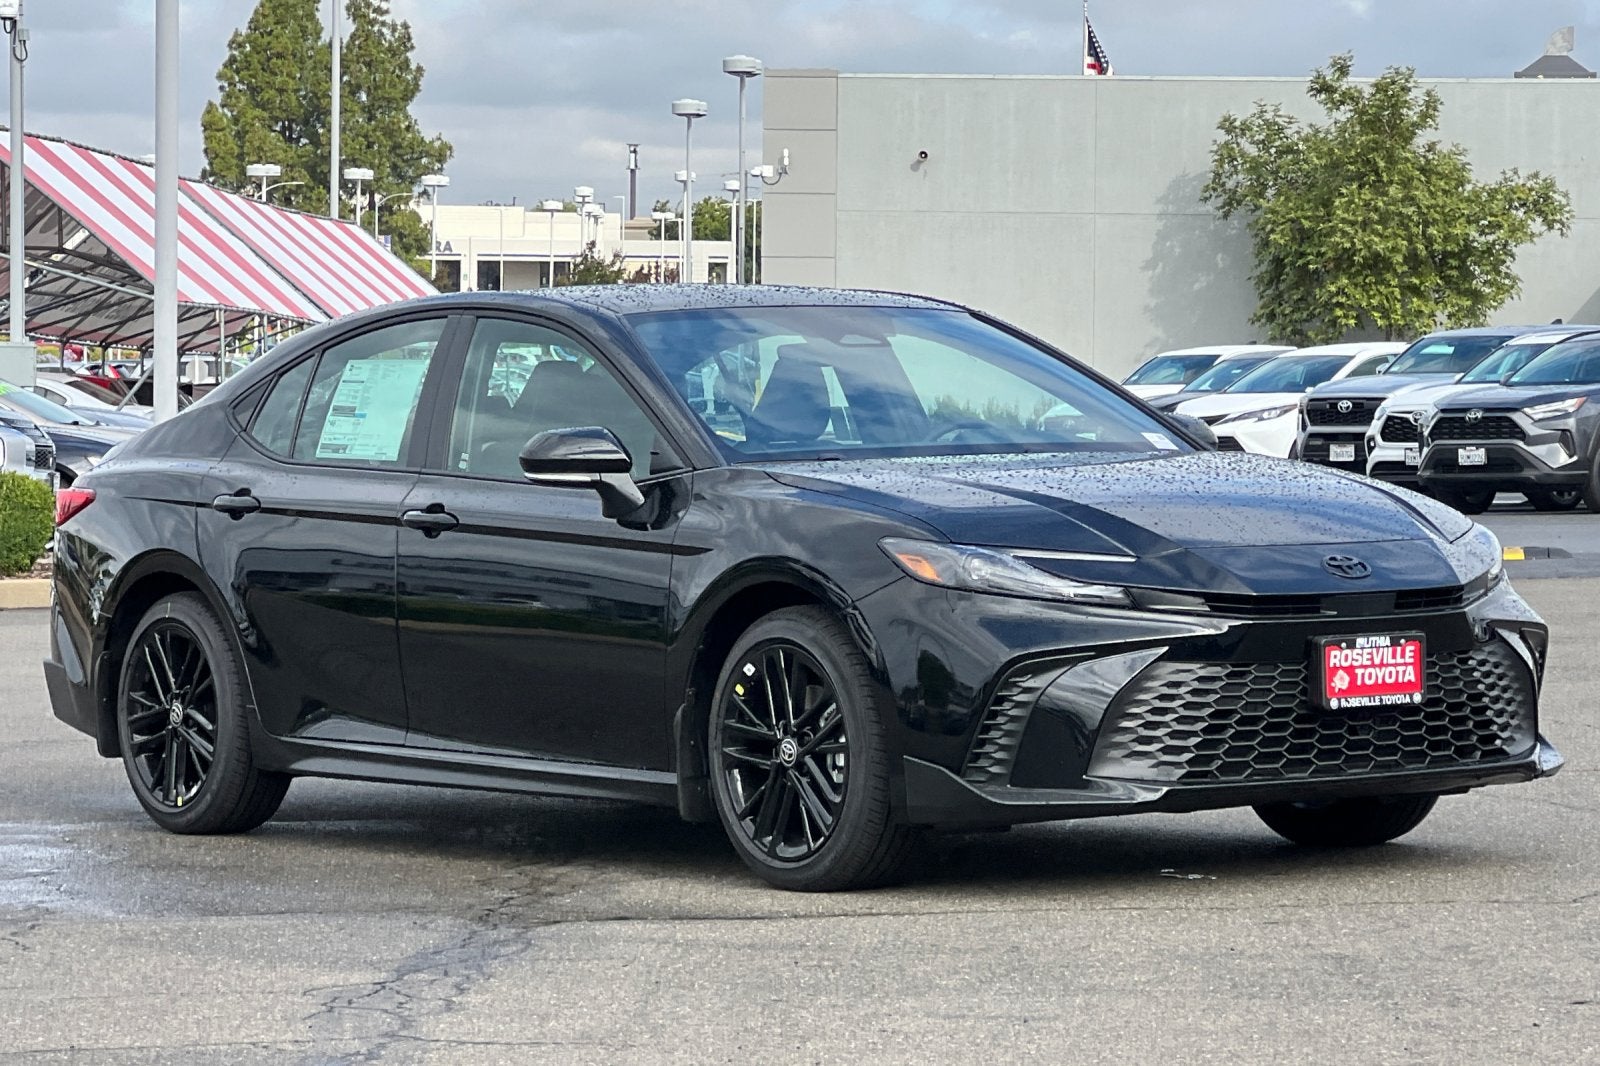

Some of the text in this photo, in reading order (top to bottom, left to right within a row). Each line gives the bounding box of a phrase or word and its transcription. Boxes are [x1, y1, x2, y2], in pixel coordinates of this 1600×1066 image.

[1329, 646, 1415, 668] ROSEVILLE
[1355, 666, 1416, 686] TOYOTA
[1340, 694, 1411, 708] ROSEVILLE TOYOTA
